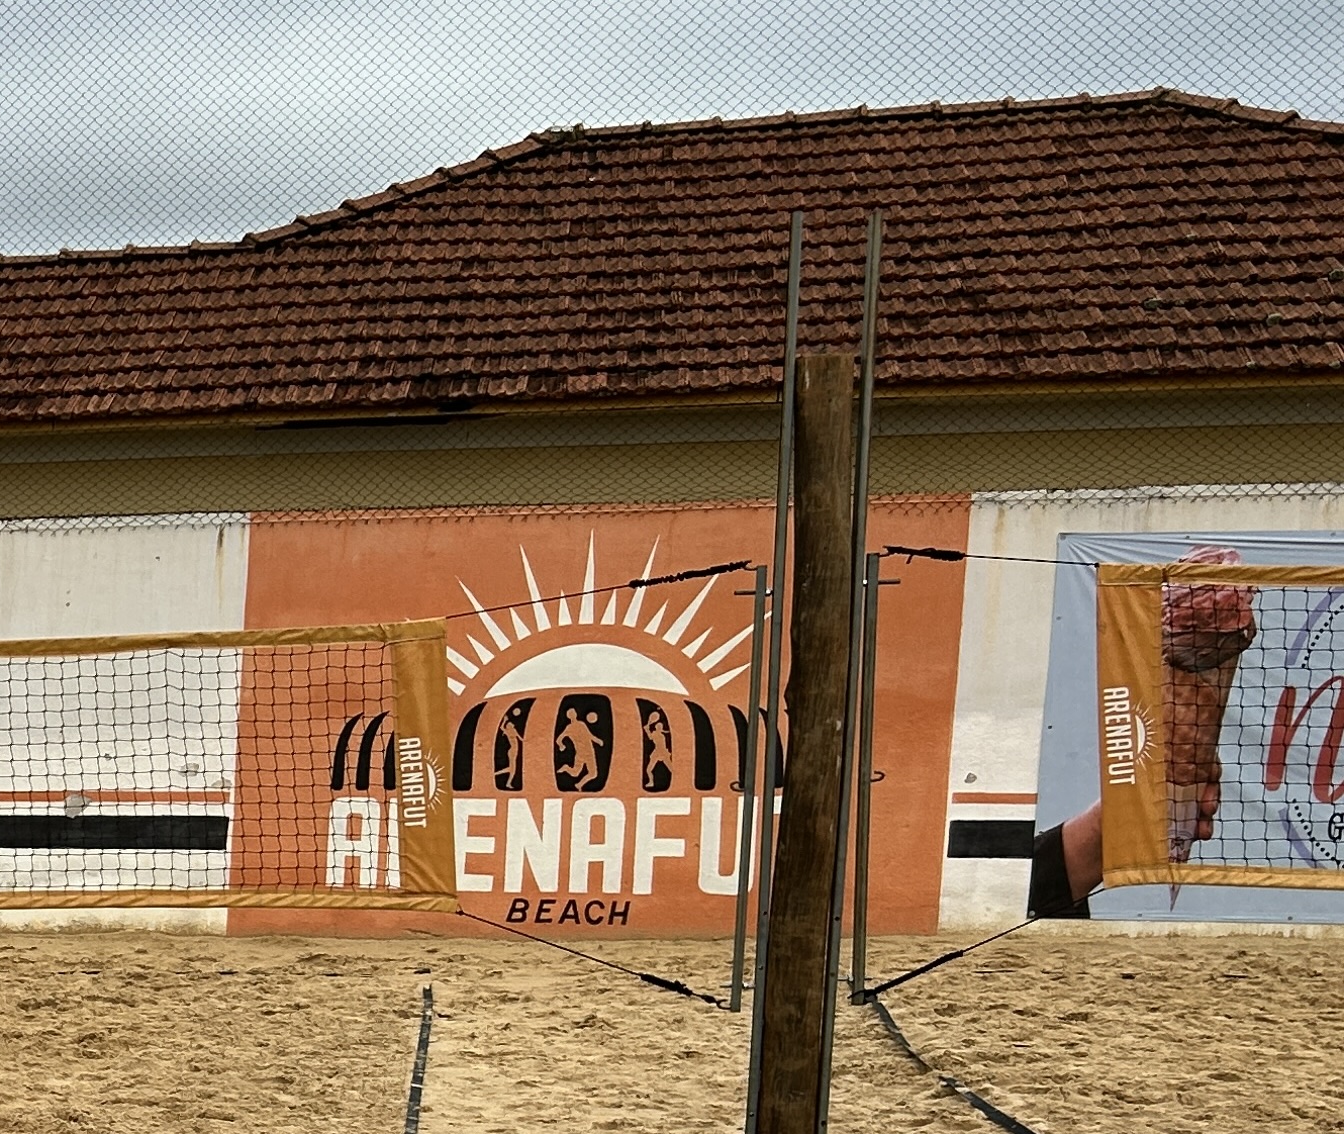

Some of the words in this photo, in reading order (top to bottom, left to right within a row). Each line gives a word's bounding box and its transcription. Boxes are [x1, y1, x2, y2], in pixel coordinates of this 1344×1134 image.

[398, 737, 428, 829] ARENAFUT
[1103, 686, 1136, 785] ARENAFUT
[325, 795, 783, 897] AENAFU
[506, 898, 631, 925] BEACH
